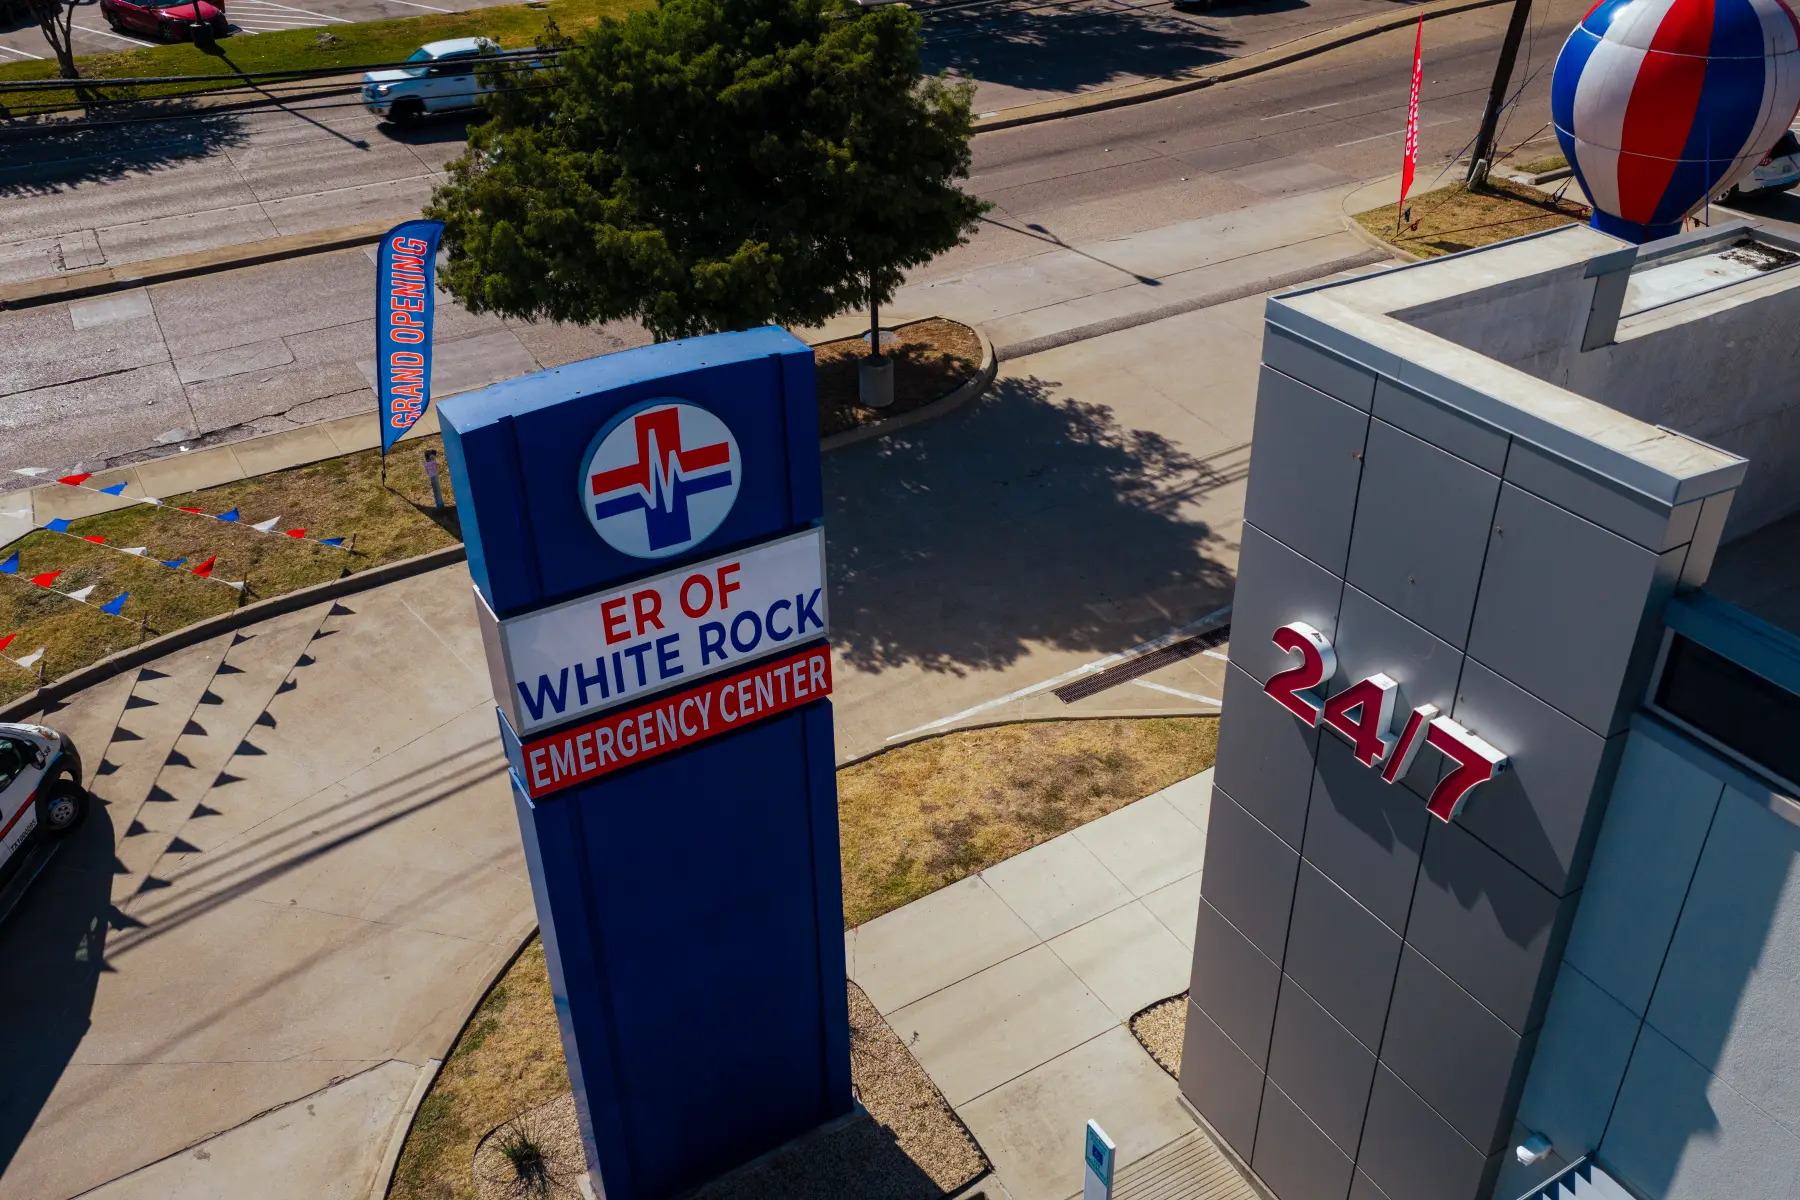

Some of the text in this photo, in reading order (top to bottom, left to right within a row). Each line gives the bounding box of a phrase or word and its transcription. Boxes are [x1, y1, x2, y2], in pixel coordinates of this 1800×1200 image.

[390, 236, 428, 428] GRAND OPENING
[517, 587, 825, 721] WHITE ROCK
[600, 562, 742, 646] ER OF
[529, 655, 828, 789] EMERGENCY CENTER
[1264, 622, 1507, 823] 24/7
